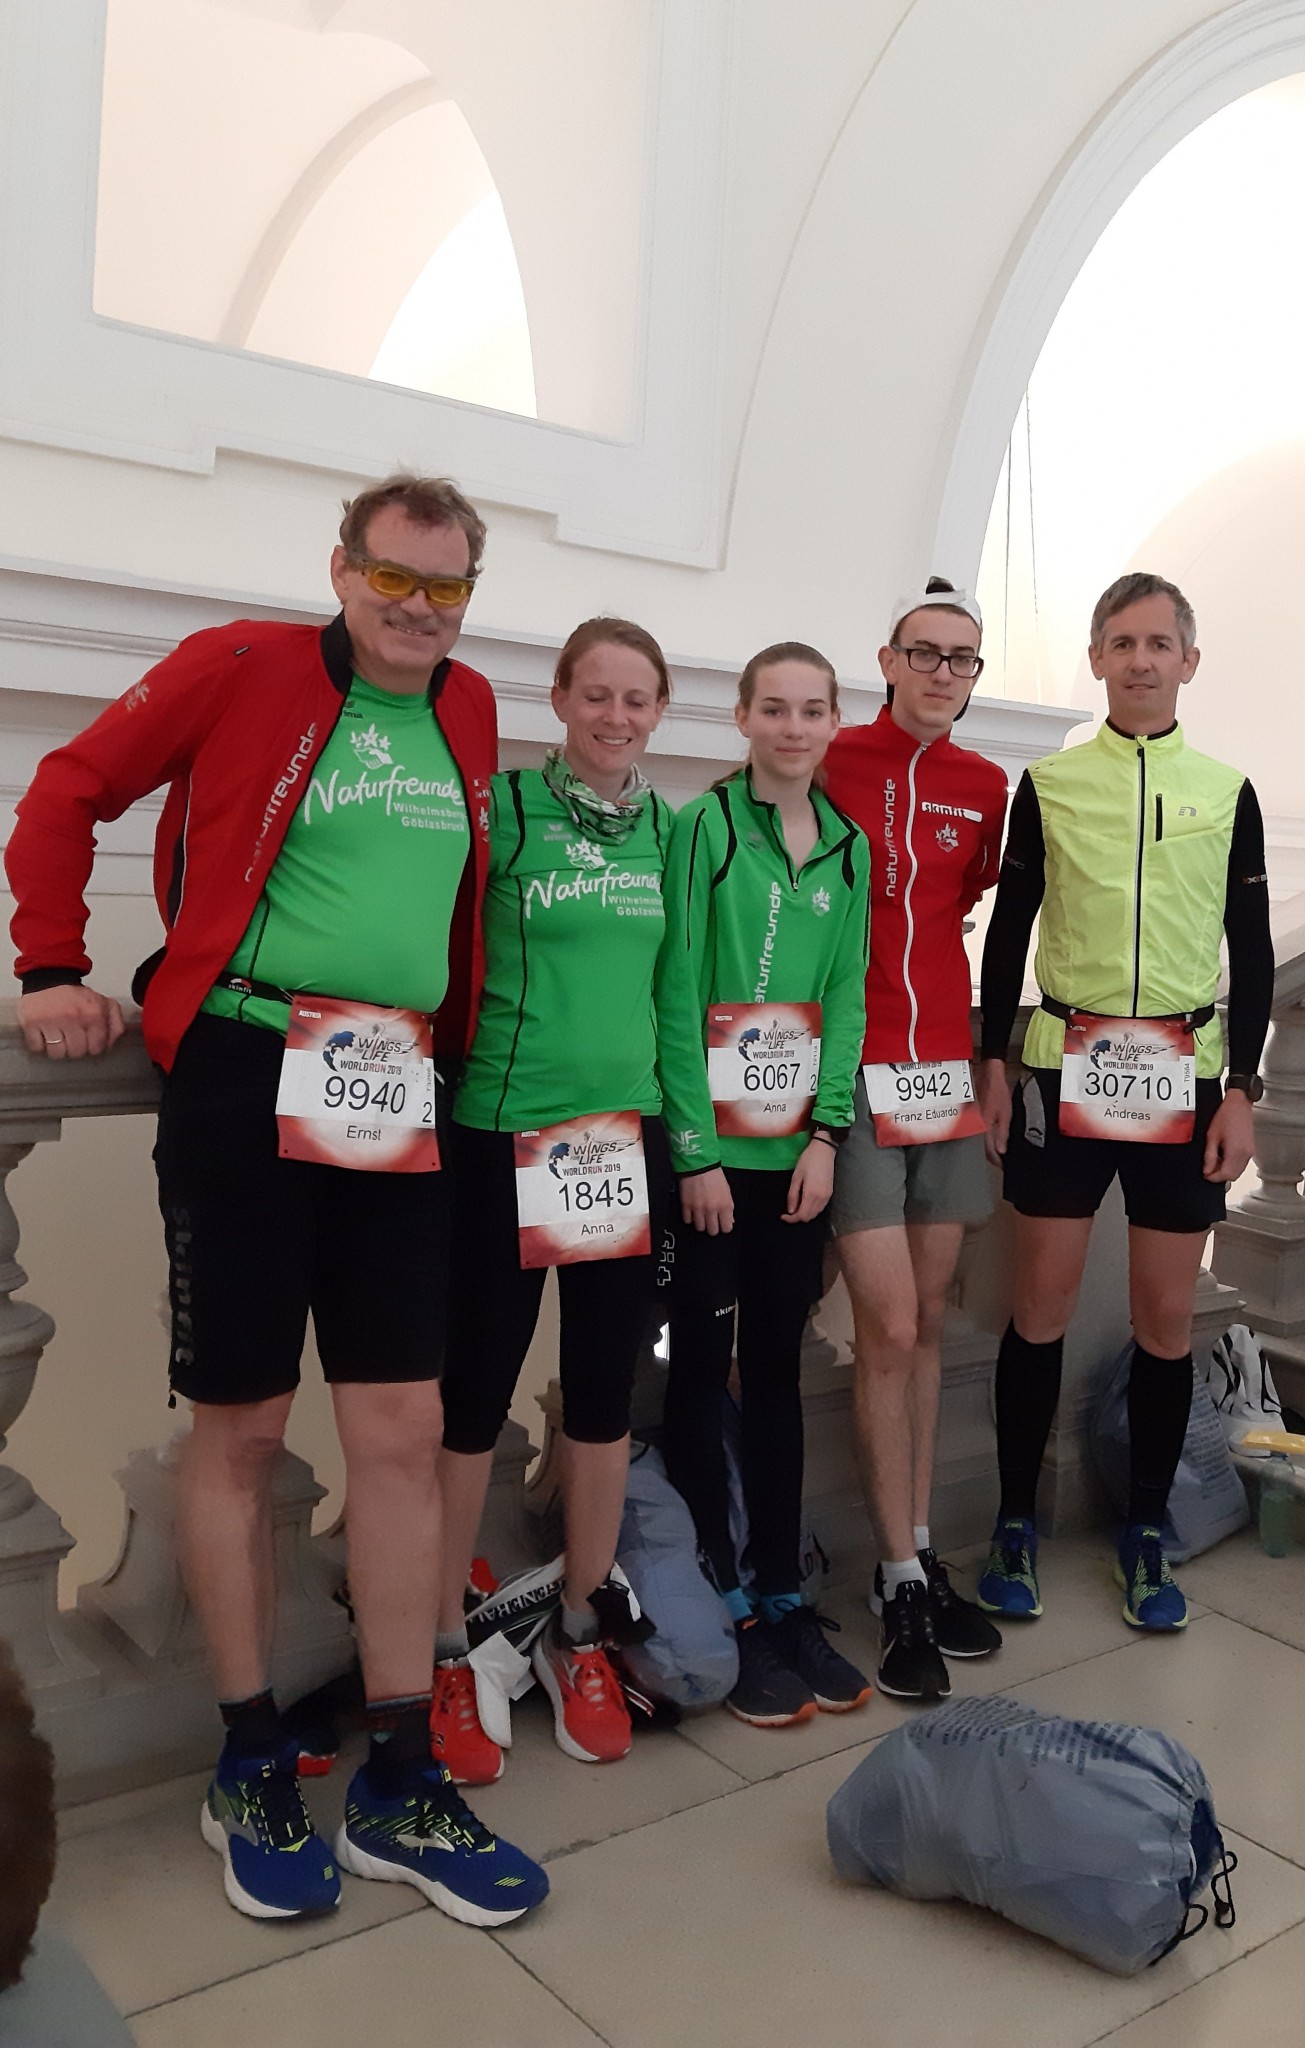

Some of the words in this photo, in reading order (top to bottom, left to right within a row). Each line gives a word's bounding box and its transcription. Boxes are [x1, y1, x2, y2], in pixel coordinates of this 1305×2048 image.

[303, 765, 466, 825] Naturfreunde
[925, 803, 966, 818] skinfit
[884, 778, 899, 898] naturfreunde
[755, 881, 782, 1003] aturfreunde
[763, 1029, 795, 1041] WINGS
[359, 1036, 402, 1053] WINGS
[768, 1040, 785, 1050] LIFE
[1113, 1042, 1153, 1053] WINGS
[361, 1050, 390, 1063] LIFE
[1118, 1053, 1140, 1061] LIFE
[743, 1063, 801, 1092] 6067
[809, 1074, 817, 1092] 2
[895, 1071, 952, 1101] 9942
[962, 1081, 971, 1099] 2
[1084, 1071, 1172, 1101] 30710
[323, 1075, 406, 1115] 9940
[1182, 1090, 1190, 1107] 1
[421, 1101, 433, 1123] 2
[763, 1102, 787, 1113] Anna
[894, 1112, 923, 1123] Franz
[925, 1107, 959, 1120] Eduardo
[1104, 1108, 1151, 1121] Andreas
[346, 1125, 382, 1141] Ernst
[573, 1141, 618, 1155] WINGS
[579, 1153, 605, 1165] LIFE
[604, 1163, 621, 1173] 2019
[558, 1177, 634, 1212] 1845
[581, 1223, 615, 1236] Anna
[467, 1579, 566, 1624] GENERAL
